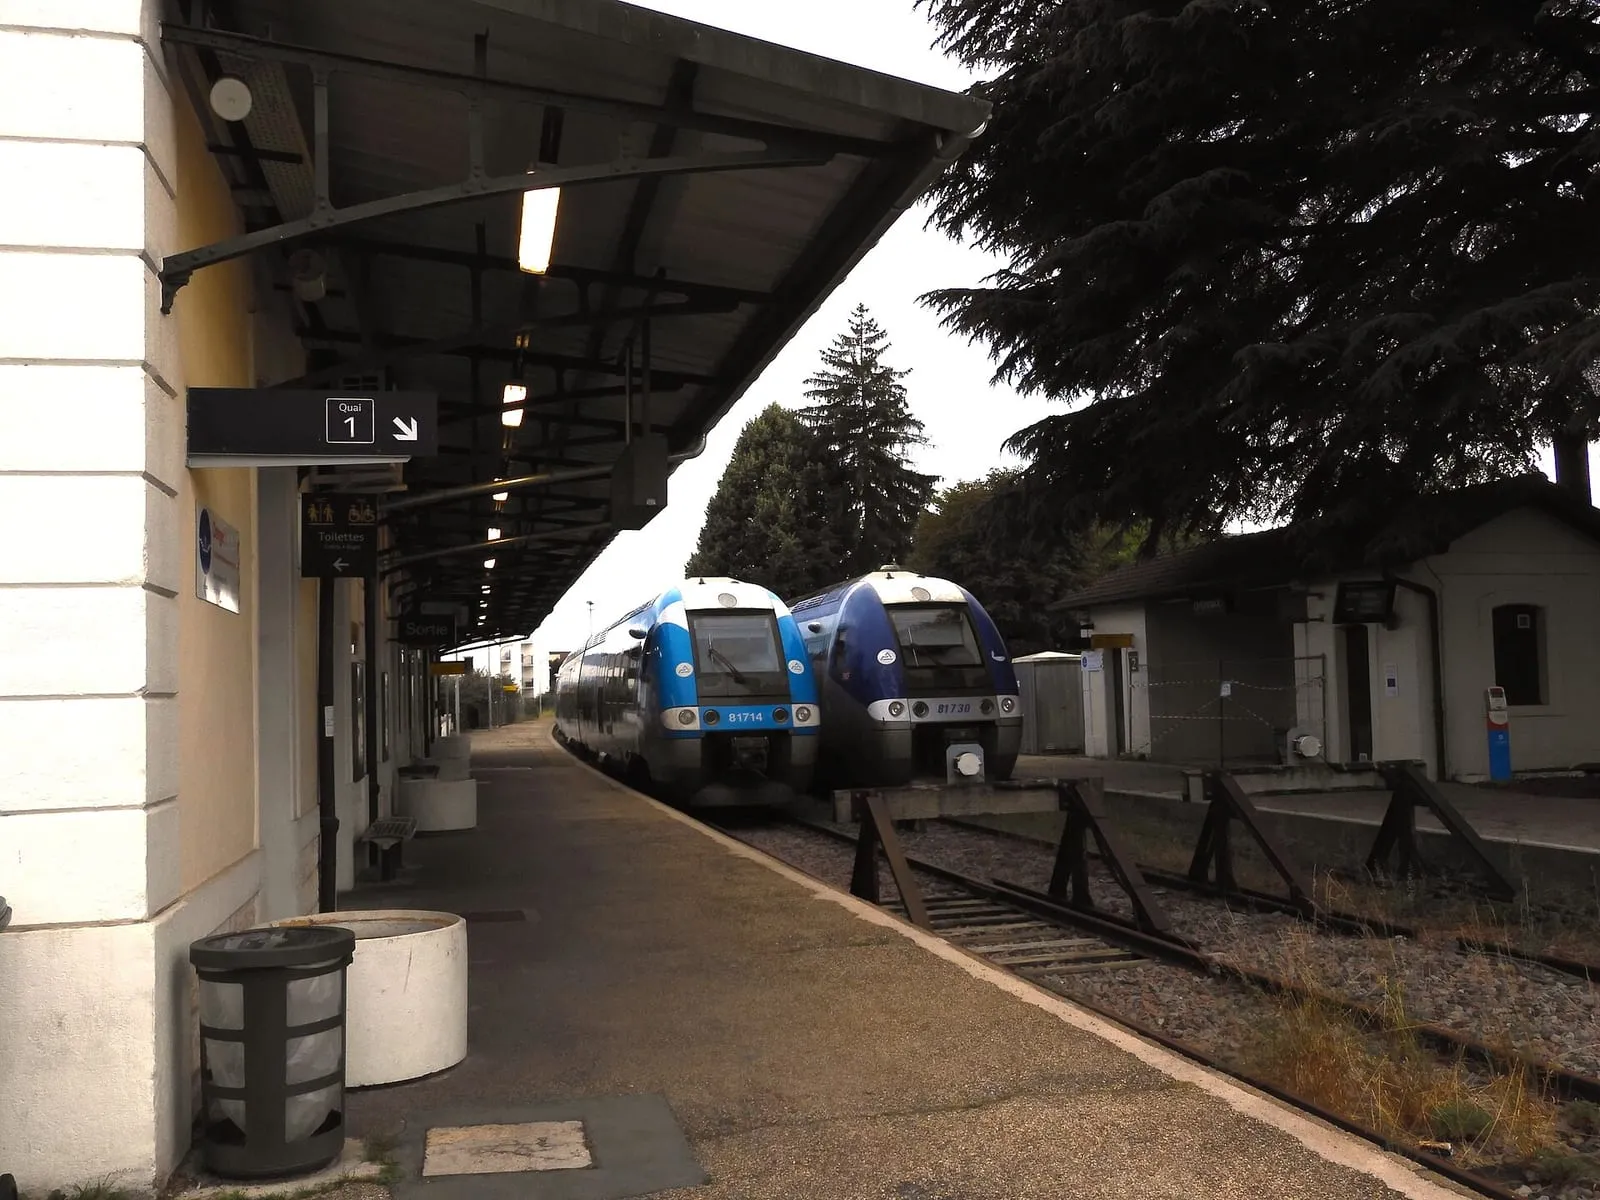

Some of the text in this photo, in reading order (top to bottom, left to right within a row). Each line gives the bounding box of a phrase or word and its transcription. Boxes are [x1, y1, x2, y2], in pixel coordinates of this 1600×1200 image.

[338, 402, 363, 413] Quai
[343, 416, 355, 439] 1
[318, 531, 365, 542] Toilettes
[406, 621, 449, 636] Sortie
[937, 703, 971, 714] 81730
[728, 712, 764, 722] 81714
